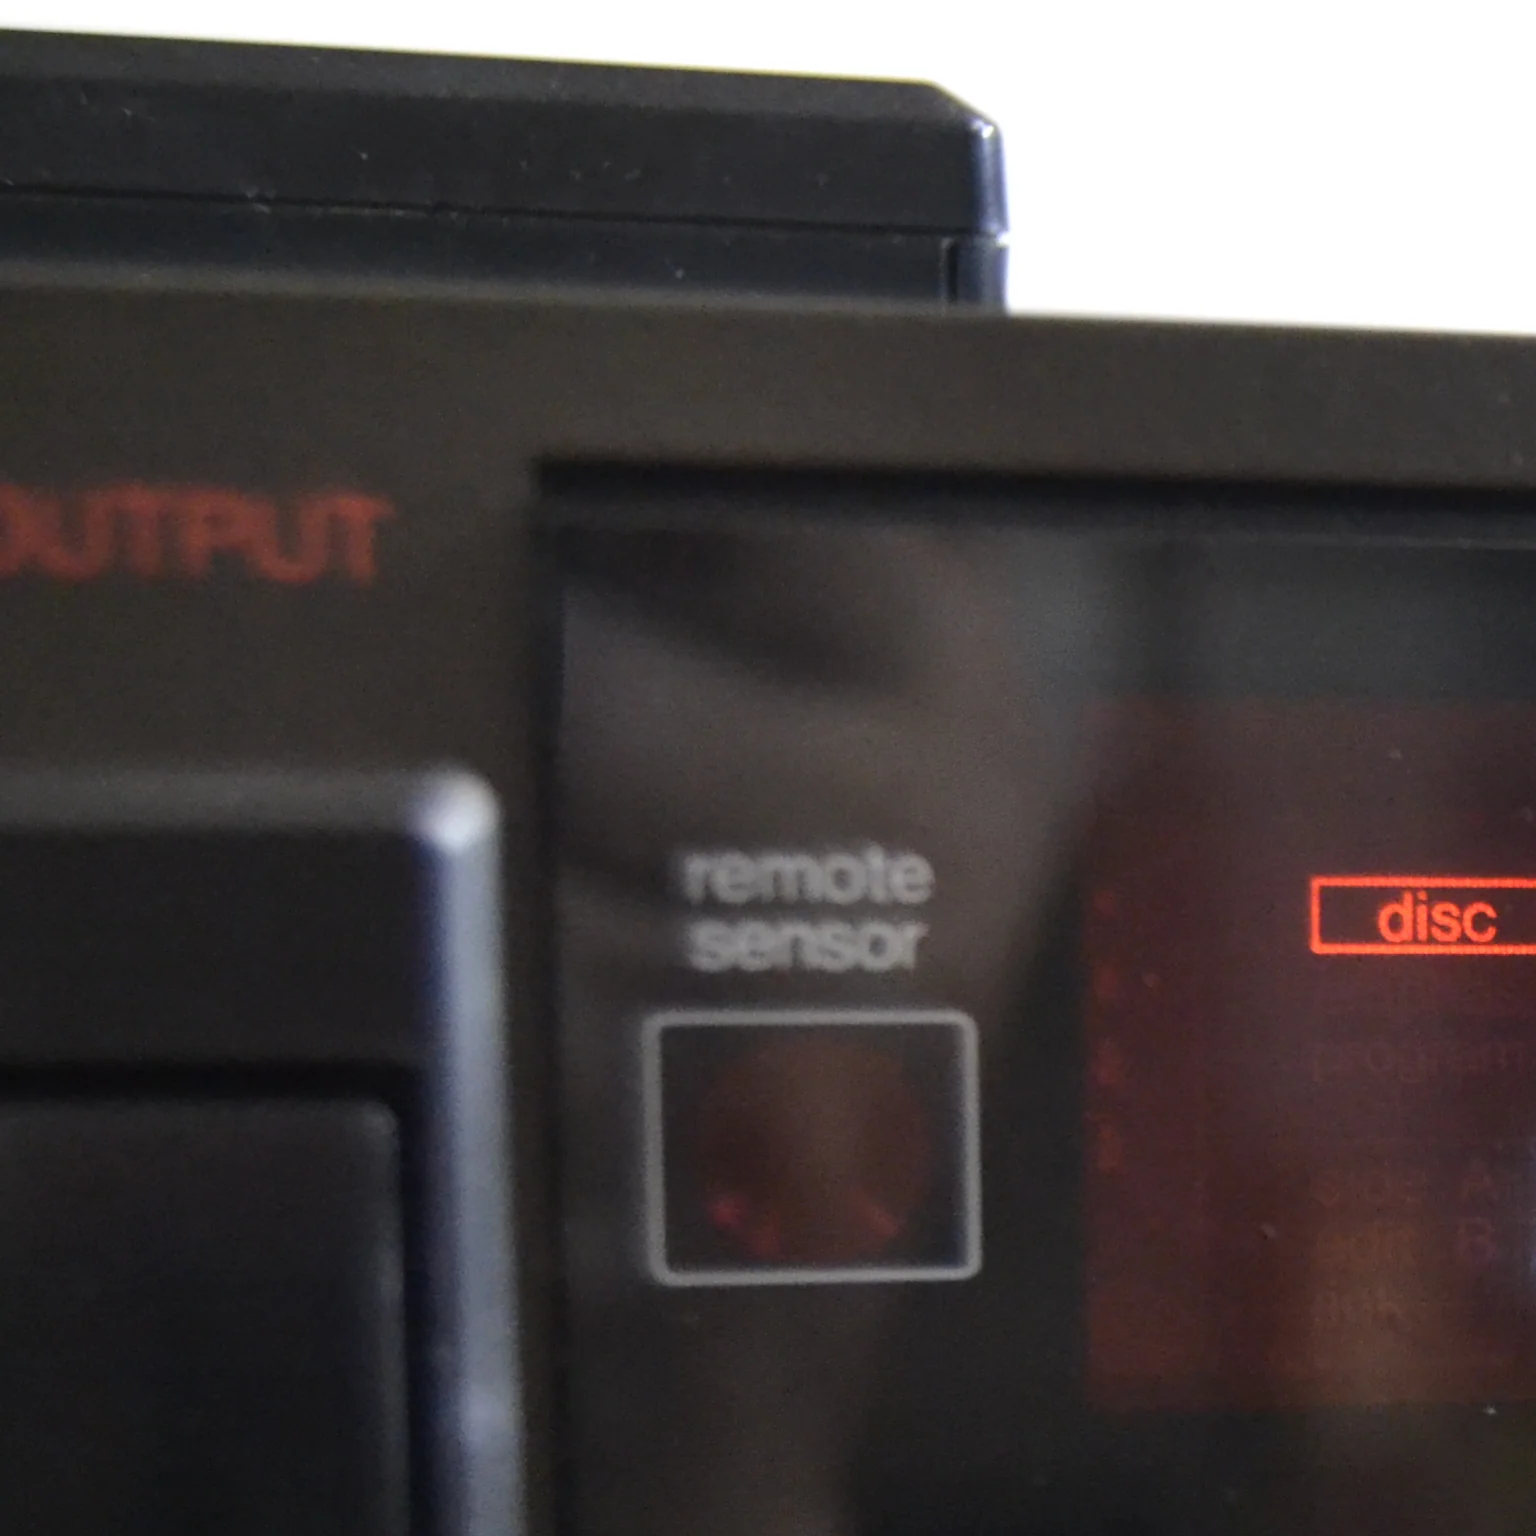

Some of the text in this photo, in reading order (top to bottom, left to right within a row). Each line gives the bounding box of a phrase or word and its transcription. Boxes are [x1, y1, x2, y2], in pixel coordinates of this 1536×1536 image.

[684, 842, 936, 906] remote
[688, 916, 929, 972] sensor
[1376, 892, 1499, 943] disc
